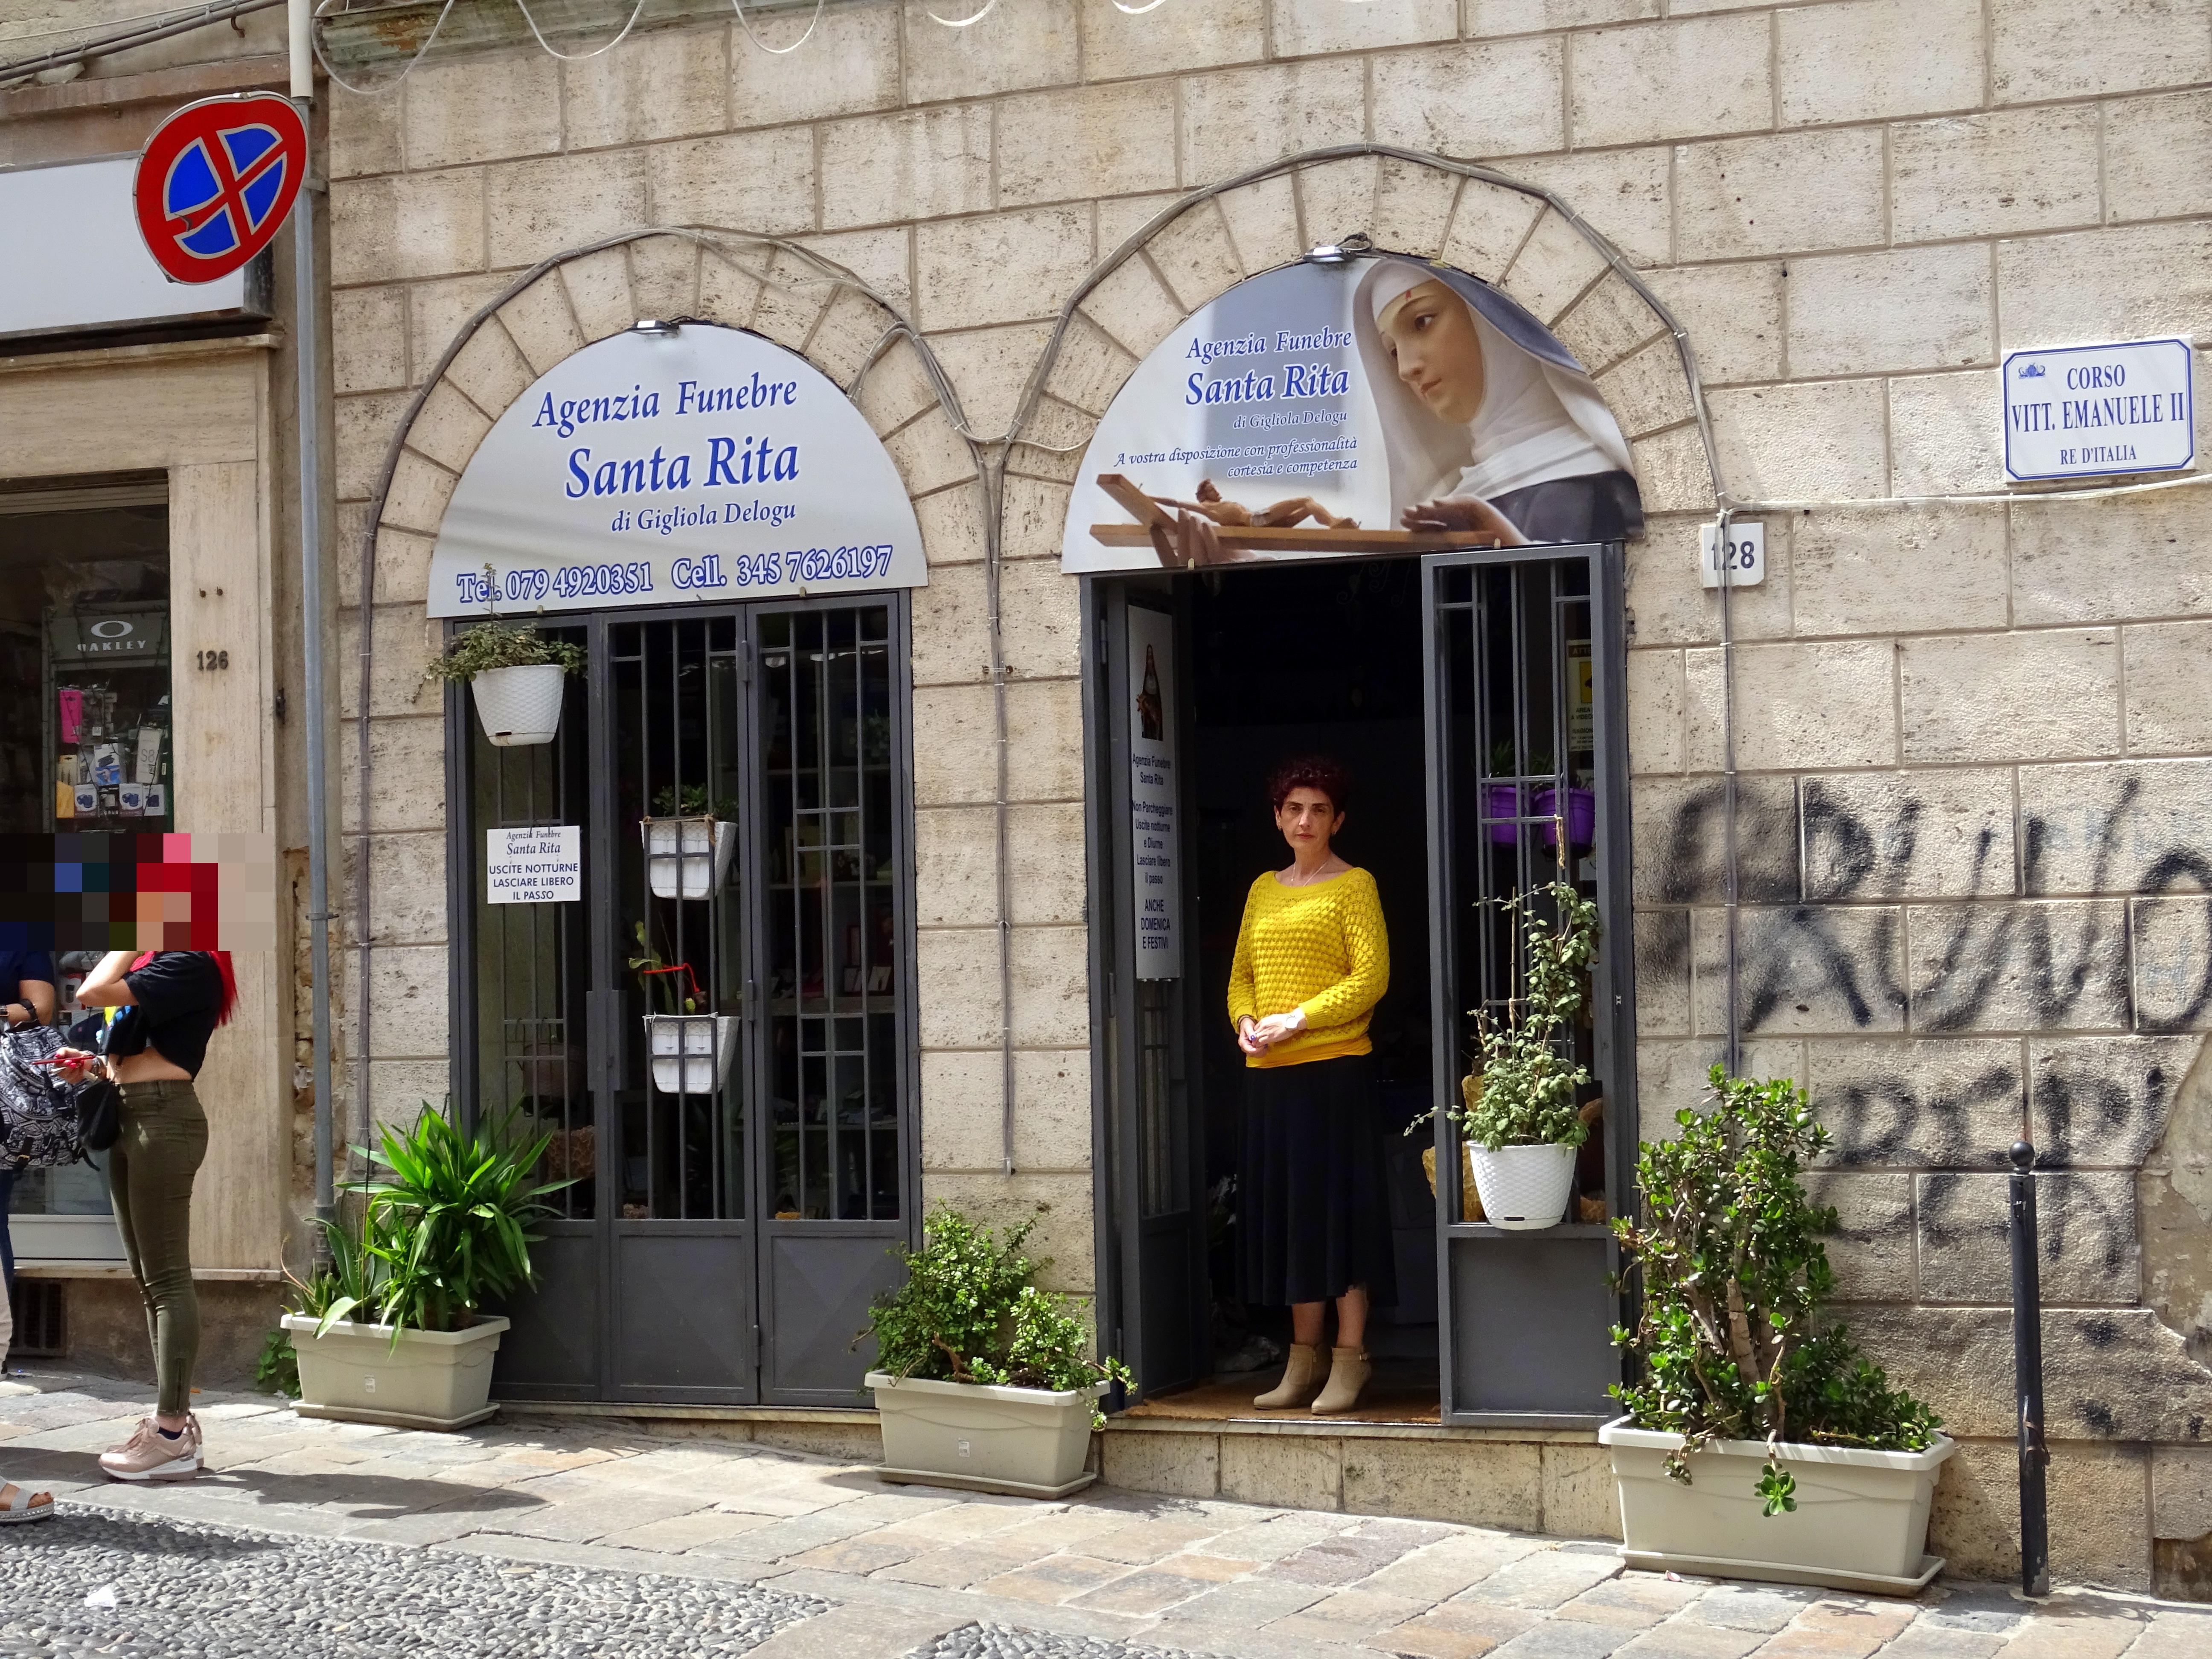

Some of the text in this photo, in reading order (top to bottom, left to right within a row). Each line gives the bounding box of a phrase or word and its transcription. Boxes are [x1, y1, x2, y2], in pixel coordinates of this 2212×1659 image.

[1186, 326, 1352, 364] Agenzia Funebre
[1186, 364, 1348, 405] Santa Rita
[2067, 365, 2125, 390] CORSO
[532, 372, 796, 438] Agenzia Funebre
[2012, 393, 2184, 432] VITT. EMANUELE II
[1234, 408, 1347, 430] di Gigliola Delogu
[1114, 436, 1357, 467] A vostra disposizione con professionalità
[2061, 445, 2136, 464] RE D'ITALIA
[567, 437, 798, 498] Santa Rita
[1228, 458, 1357, 477] cortesia e competenza
[612, 500, 795, 535] di Gigliola Delogu
[1711, 541, 1755, 570] 128
[457, 545, 893, 603] Tel. 079 4920351 Cell. 345 7626197
[77, 640, 146, 652] OAKLEY
[197, 650, 228, 670] 126
[141, 749, 155, 763] S8
[1133, 754, 1170, 768] Agenzia Funebre
[1140, 771, 1164, 786] Santa Rita
[1132, 799, 1172, 817] Non Parcheggiare
[1136, 818, 1170, 832] Uscite notturne
[507, 842, 560, 855] Santa Rita
[489, 863, 577, 874] USCITE NOTTURNE
[1137, 854, 1170, 867] Lasciare libero
[494, 877, 573, 887] LASCIARE LIBERO
[1149, 874, 1163, 886] passo
[524, 891, 553, 899] PASSO
[1145, 899, 1164, 912] ANCHE
[1141, 917, 1170, 931] DOMENICA
[1143, 937, 1168, 949] E FESTIVI
